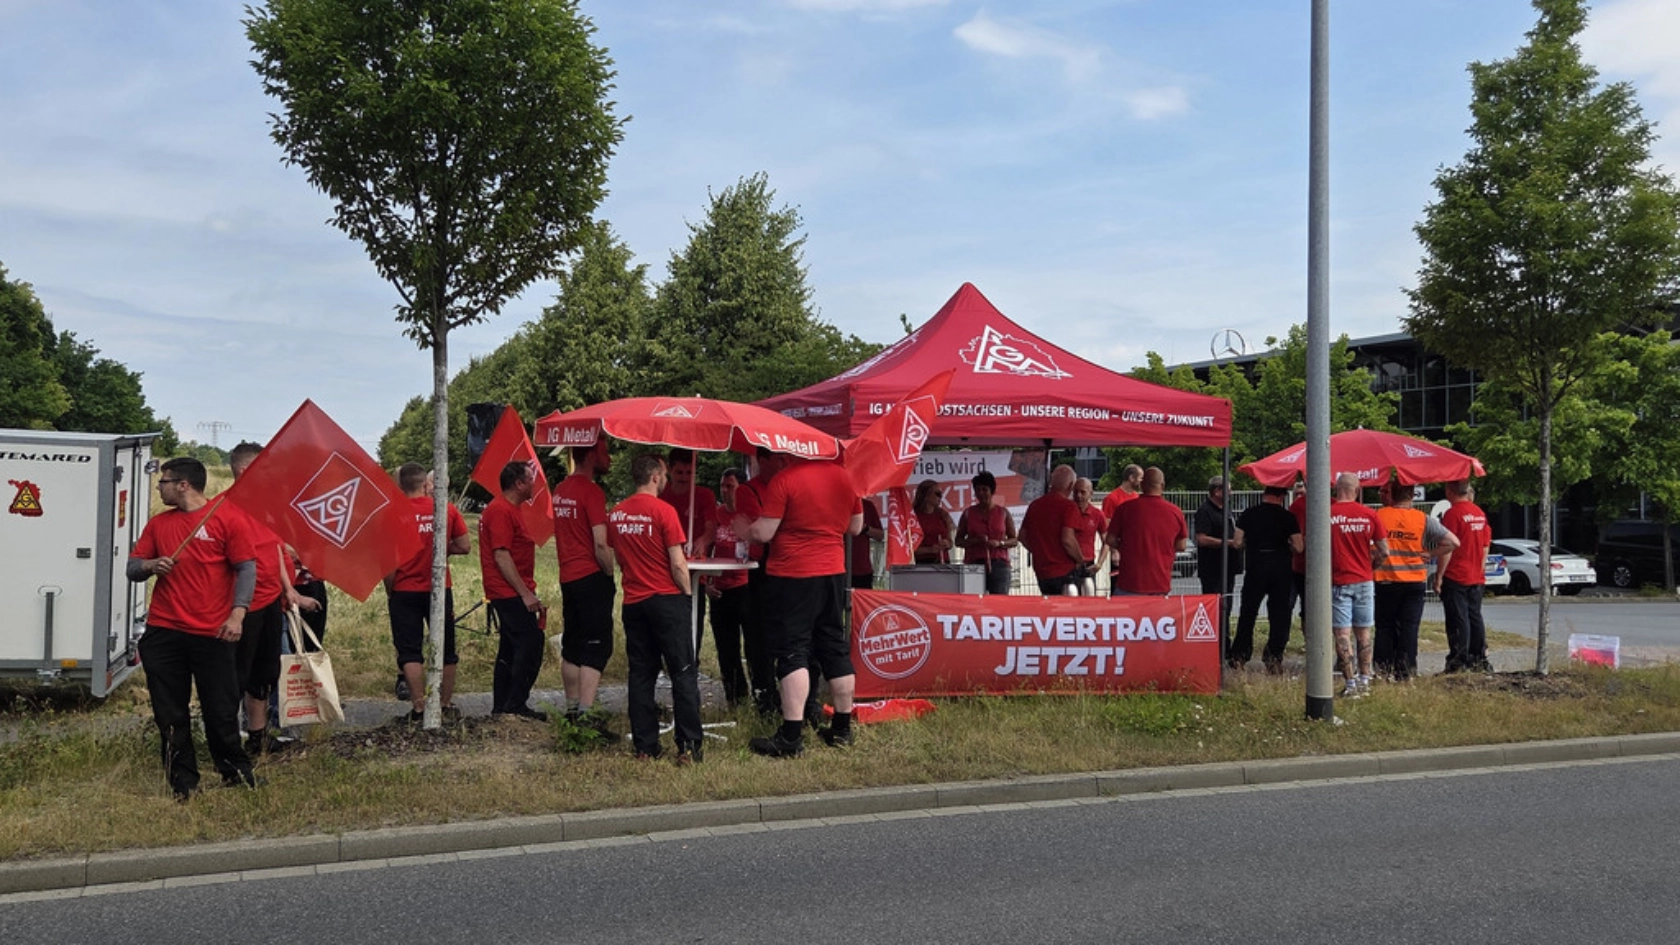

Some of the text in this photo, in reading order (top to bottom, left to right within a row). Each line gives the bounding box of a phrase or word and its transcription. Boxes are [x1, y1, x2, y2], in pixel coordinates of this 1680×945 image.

[870, 403, 883, 414] IG
[1021, 404, 1065, 418] UNSERE
[1067, 406, 1110, 420] REGION
[1121, 411, 1165, 424] UNSERE
[1166, 414, 1215, 427] ZUKUNFT
[547, 426, 560, 443] IG
[914, 457, 986, 474] rieb wird
[936, 614, 1177, 640] TARIFVERTRAG
[861, 630, 929, 652] MehrWert
[875, 648, 920, 665] mit Tarif
[993, 646, 1126, 675] JETZT!
